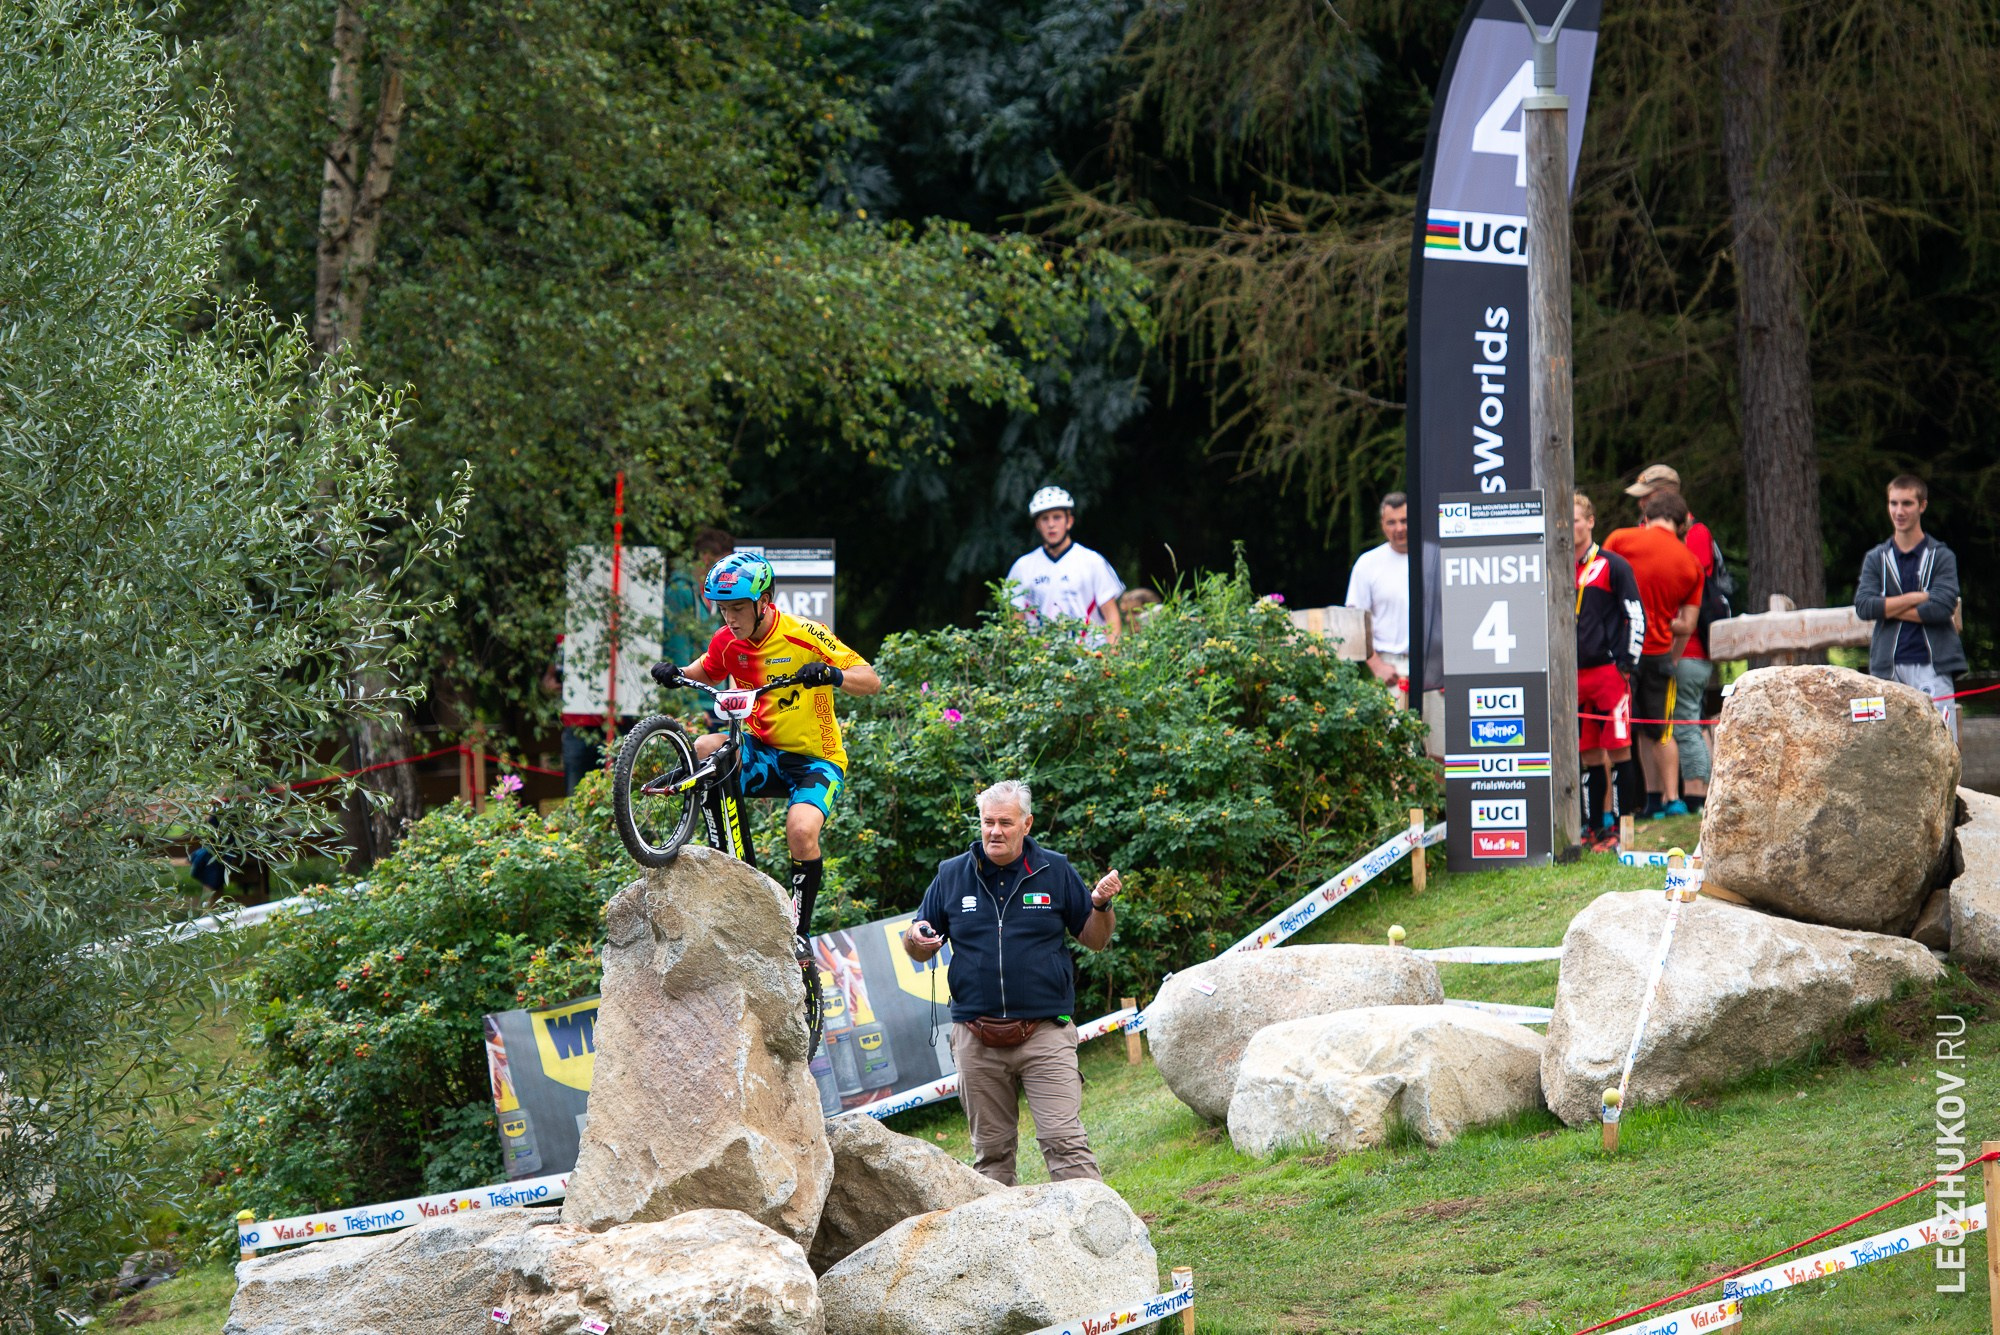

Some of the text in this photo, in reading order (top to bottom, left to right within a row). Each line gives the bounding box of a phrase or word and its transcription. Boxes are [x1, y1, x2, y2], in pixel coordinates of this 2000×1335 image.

[1472, 60, 1534, 188] 4
[1464, 221, 1528, 256] UCI
[1444, 507, 1468, 518] UCI
[1445, 555, 1540, 586] FINISH
[1472, 600, 1517, 664] 4
[723, 696, 746, 711] 307
[1484, 694, 1516, 709] UCI
[814, 693, 837, 759] ESPAÑA
[1481, 758, 1513, 772] UCI
[1471, 780, 1526, 791] #TrialsWorlds
[1486, 806, 1519, 820] UCI
[1279, 902, 1316, 935] TRENTINO
[273, 1224, 294, 1241] Val
[296, 1228, 305, 1238] di
[304, 1221, 337, 1237] Sole
[343, 1209, 404, 1231] TRENTINO
[417, 1202, 439, 1218] Val
[440, 1207, 449, 1215] di
[449, 1198, 481, 1213] Sole
[487, 1185, 548, 1207] TRENTINO
[1783, 1267, 1807, 1285] Val
[1808, 1270, 1817, 1280] di
[1814, 1259, 1846, 1277] Sole
[1850, 1237, 1909, 1267] TRENTINO
[1082, 1287, 1193, 1335] Val di Sole TRENTINO
[1691, 1310, 1709, 1330] Val
[1710, 1312, 1719, 1323] di
